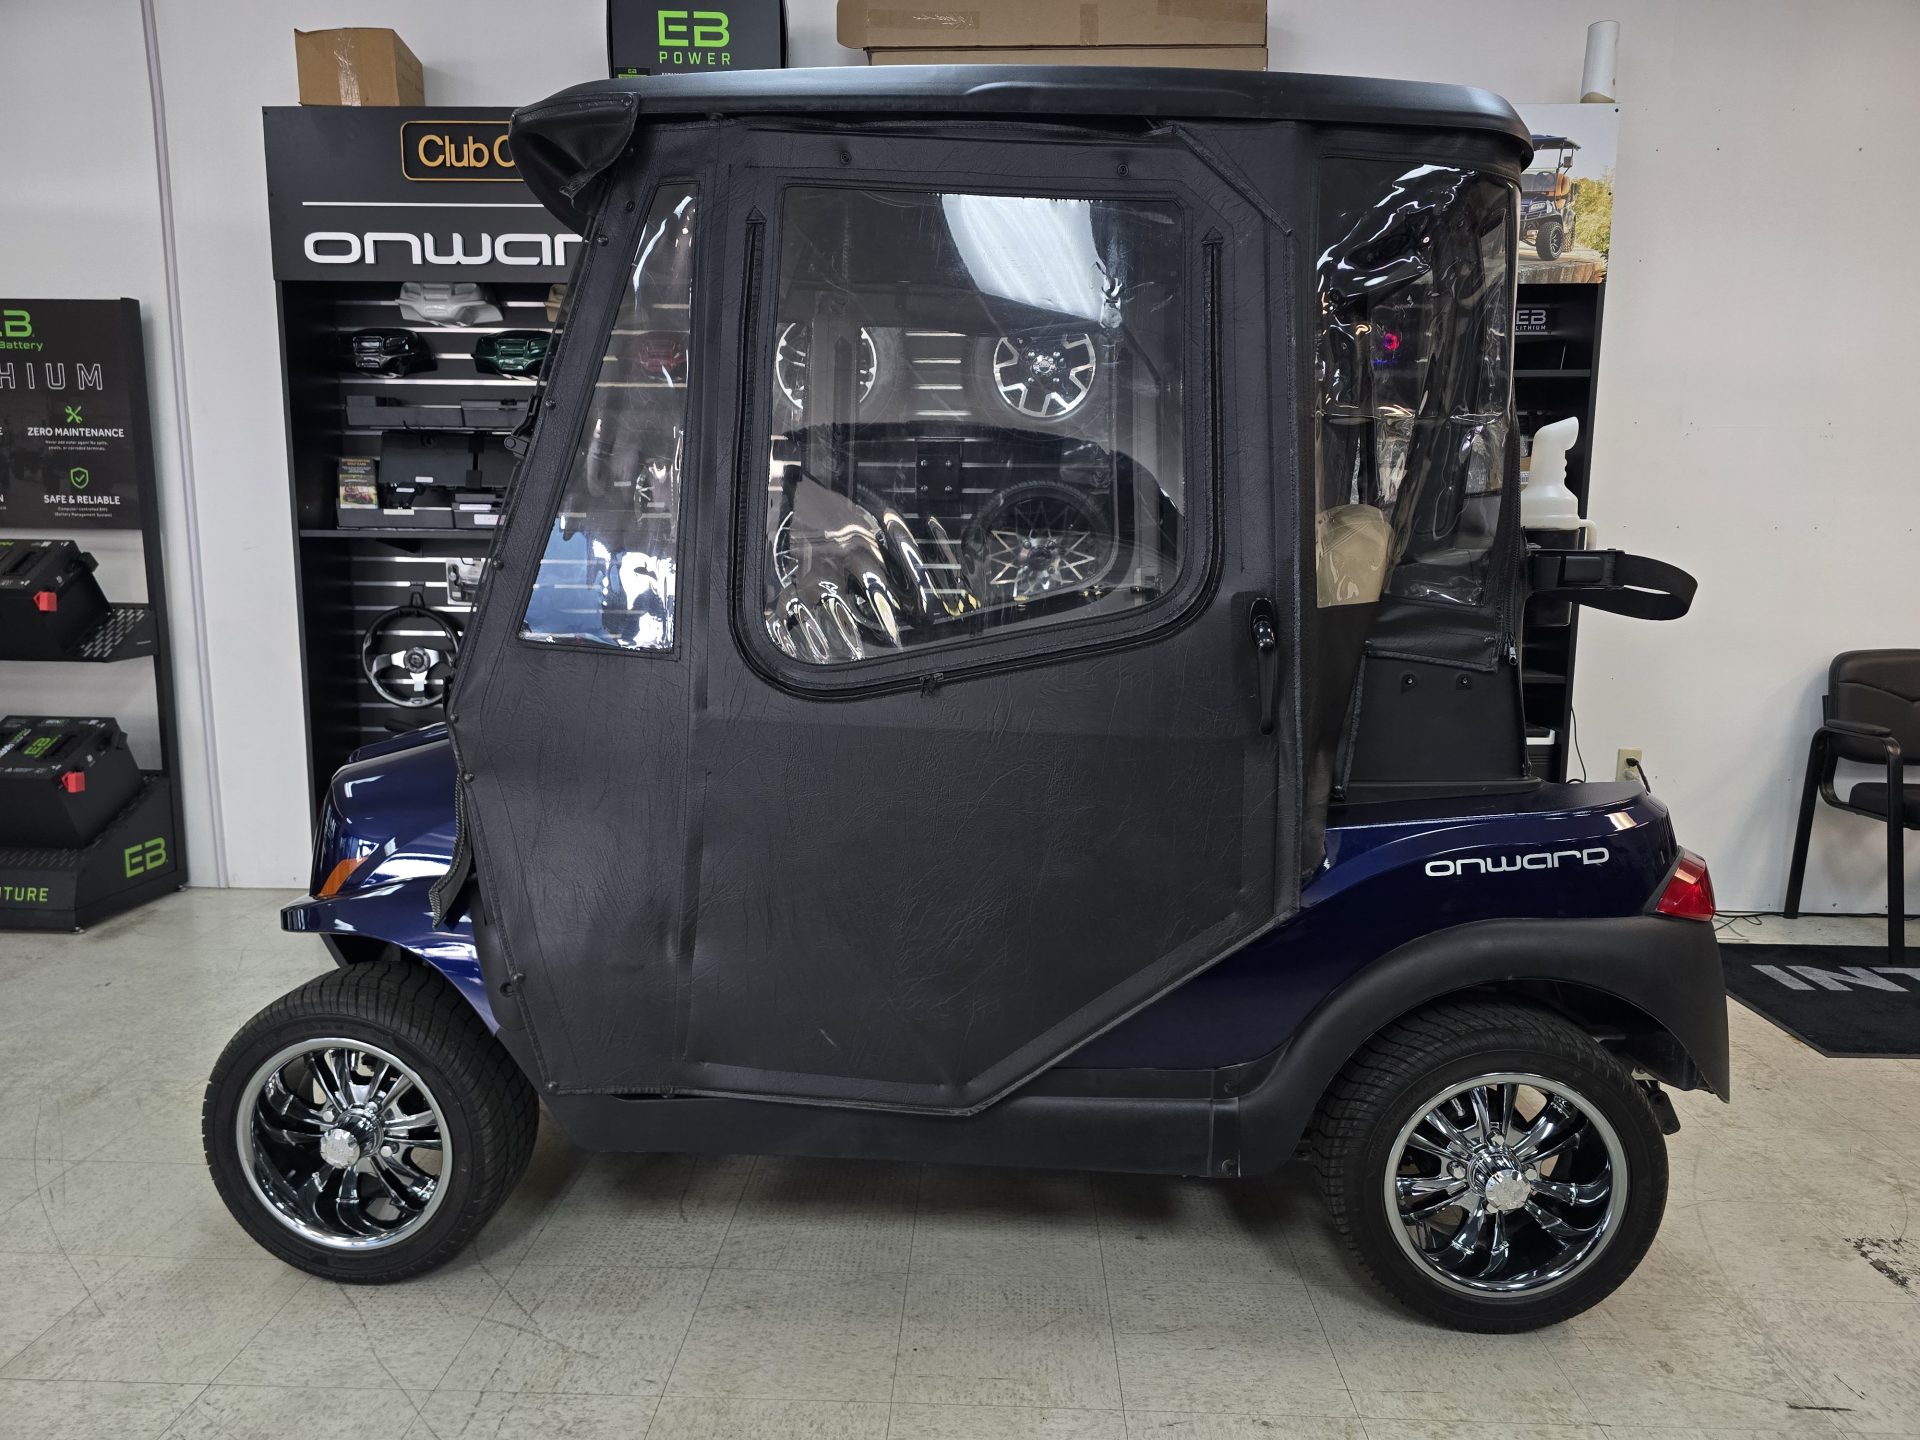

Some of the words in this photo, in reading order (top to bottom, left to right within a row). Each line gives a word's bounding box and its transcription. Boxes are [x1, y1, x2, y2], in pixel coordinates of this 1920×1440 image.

[657, 10, 730, 47] EB
[659, 51, 731, 65] POWER
[418, 134, 490, 167] Club
[0, 310, 33, 337] B
[1516, 309, 1547, 325] EB
[27, 427, 53, 436] ZERO
[55, 427, 125, 438] MAINTENANCE
[43, 494, 67, 504] SAFE
[68, 495, 76, 504] &
[77, 495, 121, 505] RELIABLE
[124, 837, 167, 877] EB
[0, 886, 49, 902] TURE
